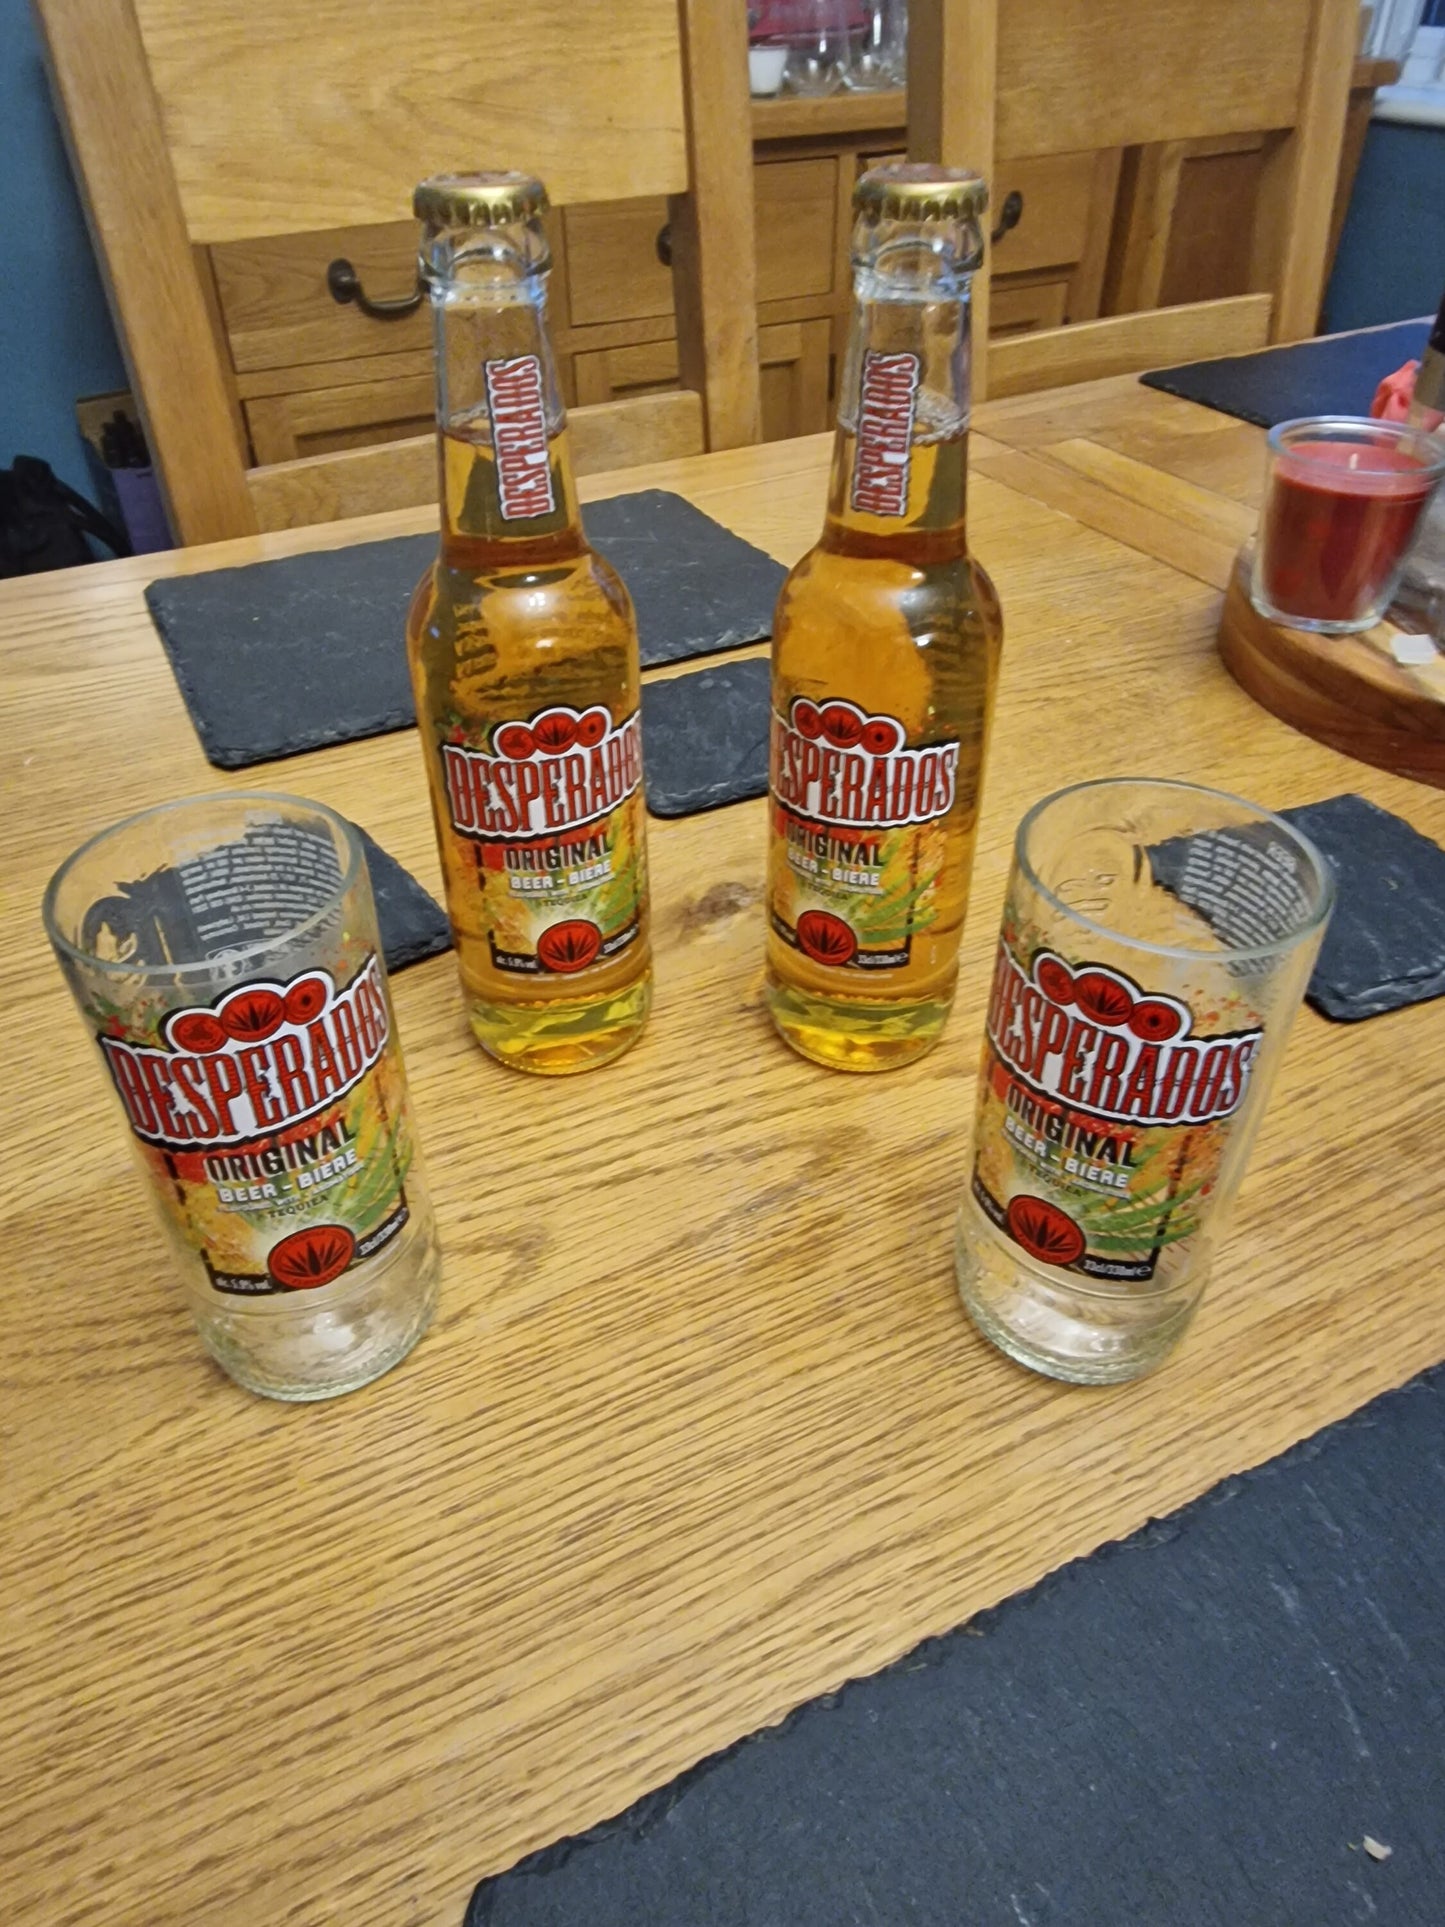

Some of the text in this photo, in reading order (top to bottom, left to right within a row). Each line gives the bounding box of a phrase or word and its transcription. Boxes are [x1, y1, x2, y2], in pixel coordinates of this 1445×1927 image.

[487, 355, 554, 519] DESPERADOS
[853, 352, 919, 515] DESPERADOS
[503, 834, 613, 873] ORIGINAL
[511, 876, 554, 890] BEER
[832, 867, 880, 887] BIERE
[104, 962, 387, 1140] DESPERADOS
[203, 1119, 357, 1183] ORIGINAL
[1005, 1114, 1047, 1158] BEER
[1064, 1156, 1129, 1188] BIERE
[1006, 1083, 1138, 1170] ORIGINAL
[218, 1182, 278, 1203] BEER
[297, 1148, 358, 1189] BIERE
